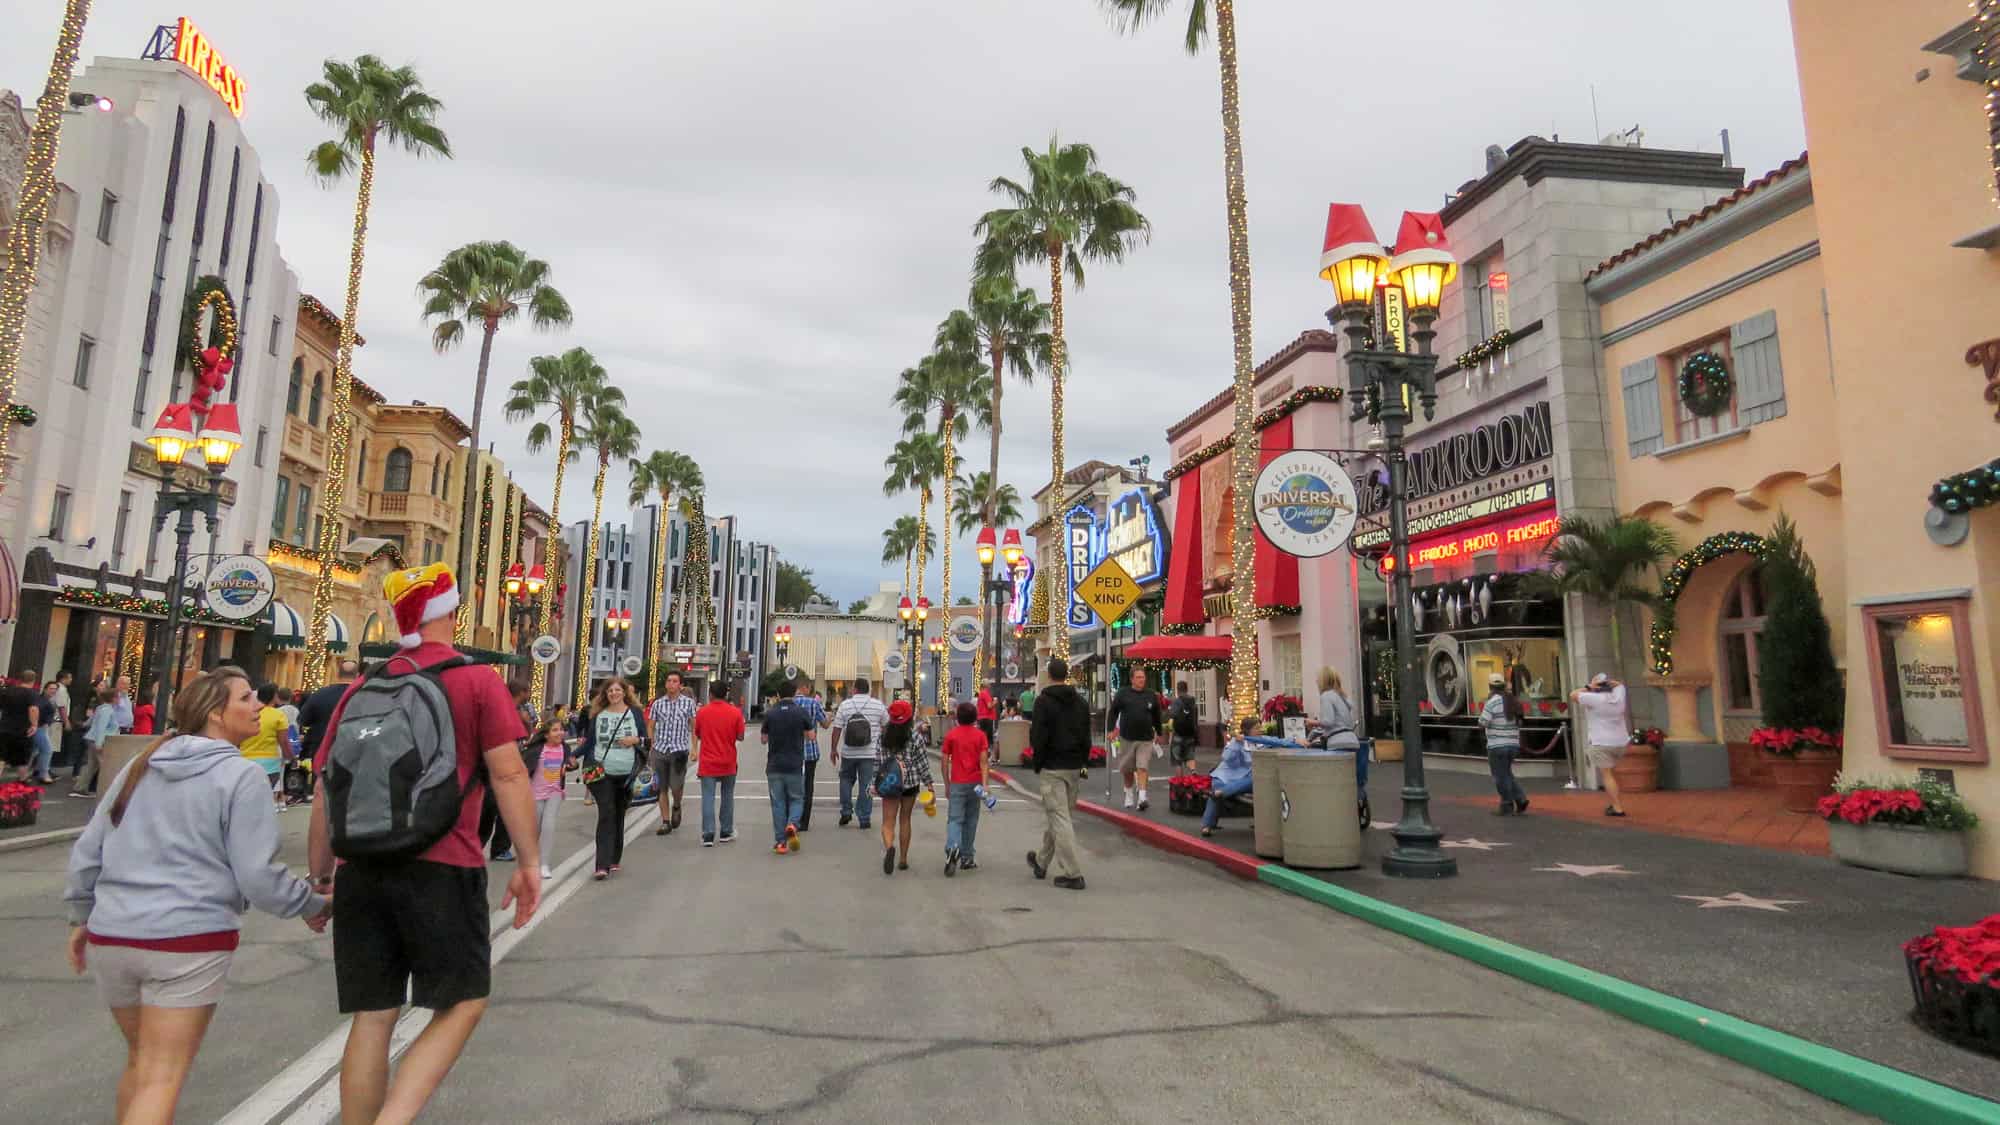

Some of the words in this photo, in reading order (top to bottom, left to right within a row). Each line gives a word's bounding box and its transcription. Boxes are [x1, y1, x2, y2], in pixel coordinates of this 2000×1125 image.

[176, 15, 246, 118] KRESS
[1406, 401, 1553, 500] ARKROOM
[1259, 489, 1346, 506] UNIVERSAL
[1419, 543, 1459, 563] FAMOUS
[1463, 532, 1498, 553] PHOTO
[1095, 576, 1122, 588] PED
[1094, 592, 1125, 605] XING
